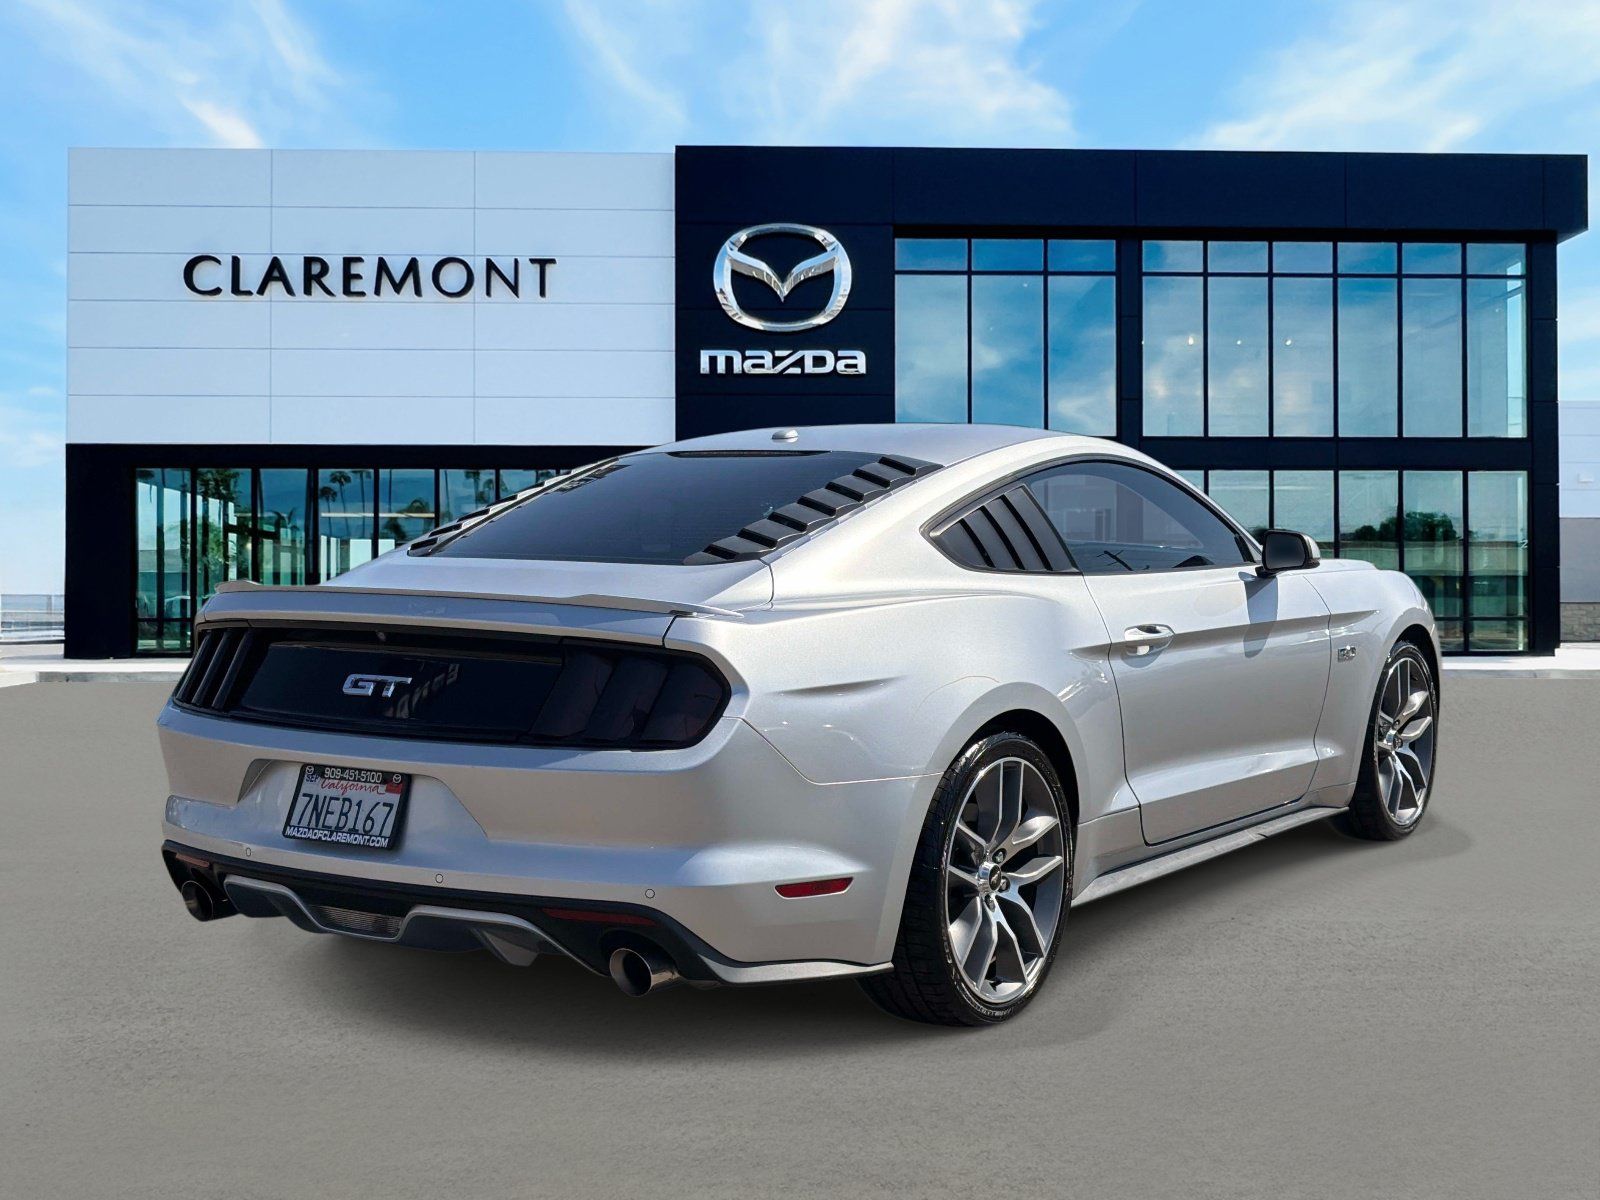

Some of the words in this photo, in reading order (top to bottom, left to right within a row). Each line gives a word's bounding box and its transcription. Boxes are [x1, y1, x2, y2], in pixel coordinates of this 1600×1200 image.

[183, 254, 557, 299] CLAREMONT
[700, 349, 867, 375] mazda
[342, 673, 412, 698] GT
[320, 778, 385, 795] California
[324, 767, 382, 783] 909-451-5100
[297, 792, 394, 836] 7NEB167
[285, 826, 389, 848] MAZDAOFCLAREMONT.COM
